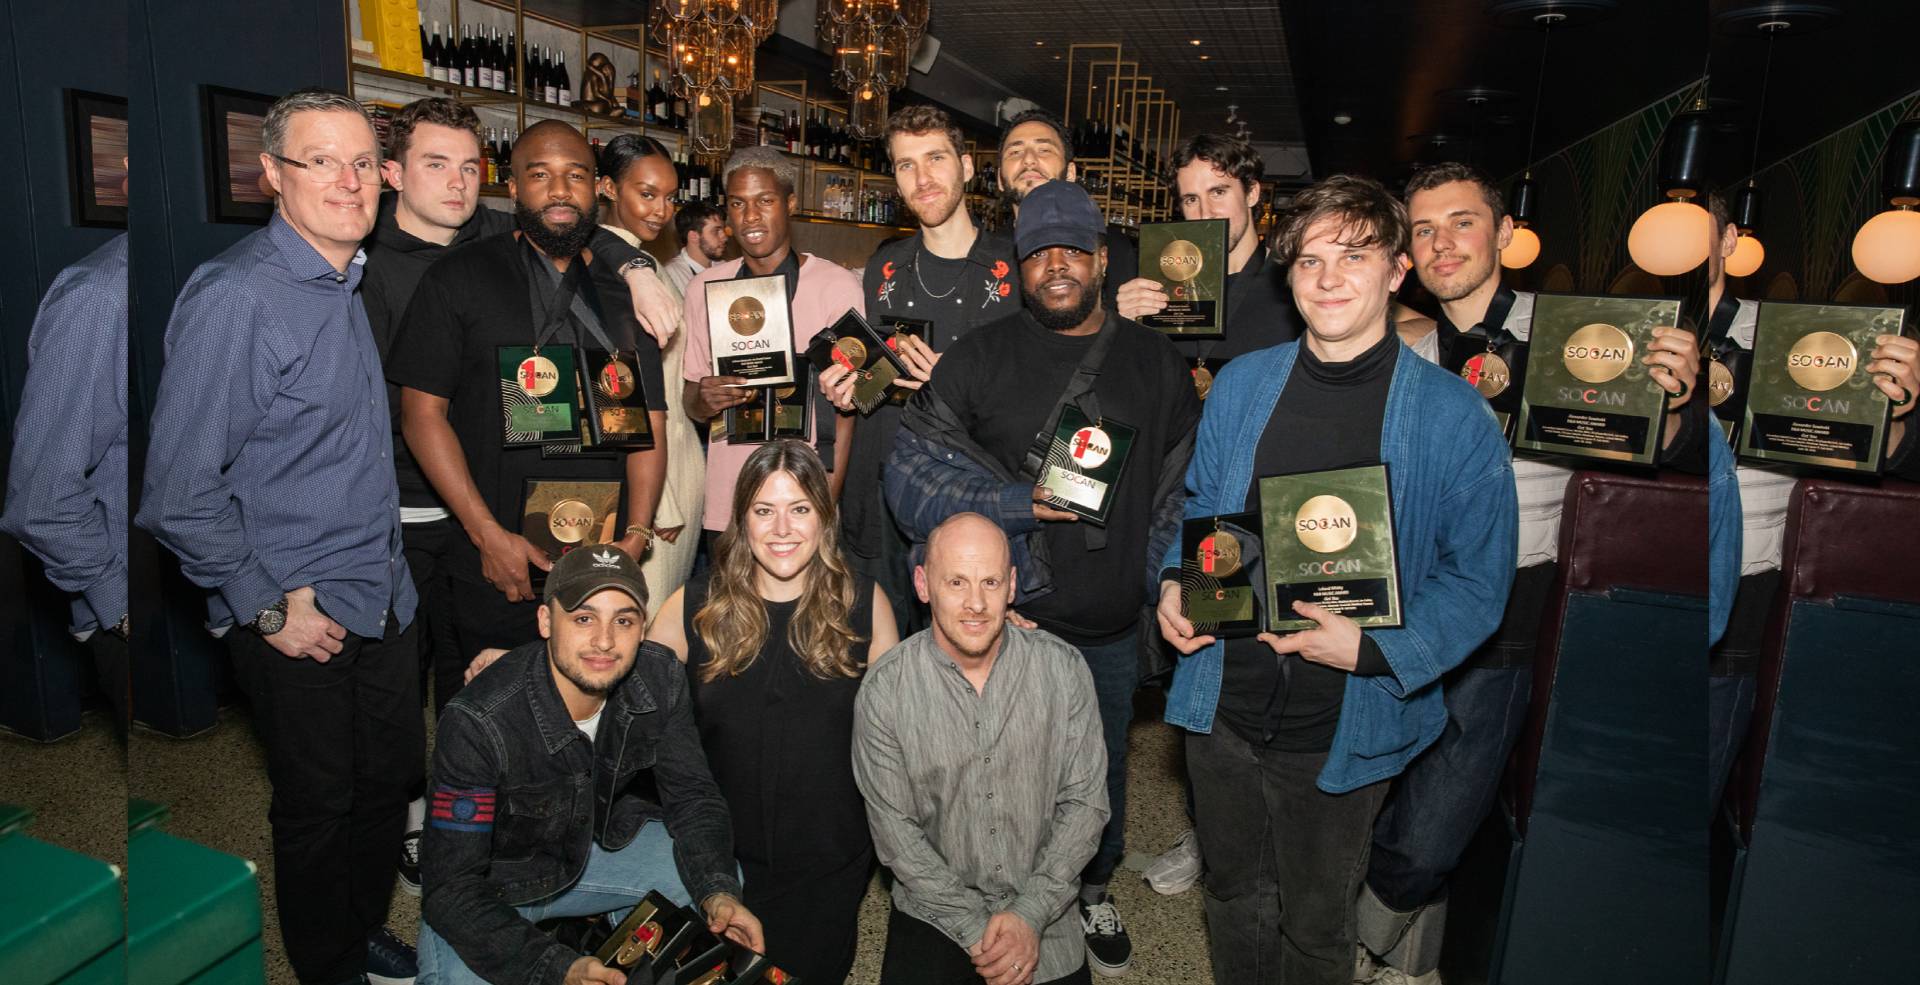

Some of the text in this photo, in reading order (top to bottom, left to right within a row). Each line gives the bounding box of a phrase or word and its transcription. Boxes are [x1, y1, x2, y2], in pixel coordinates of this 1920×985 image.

[1162, 255, 1197, 266] SOCAN
[731, 339, 770, 351] SOCAN
[1567, 346, 1625, 361] SOCAN
[1791, 354, 1850, 369] SOCAN
[1558, 387, 1626, 407] SOCAN
[1783, 395, 1850, 415] SOCAN
[1060, 471, 1097, 490] SOCAN
[553, 518, 593, 528] SOCAN
[1299, 517, 1351, 531] SOCAN
[1299, 559, 1361, 577] SOCAN
